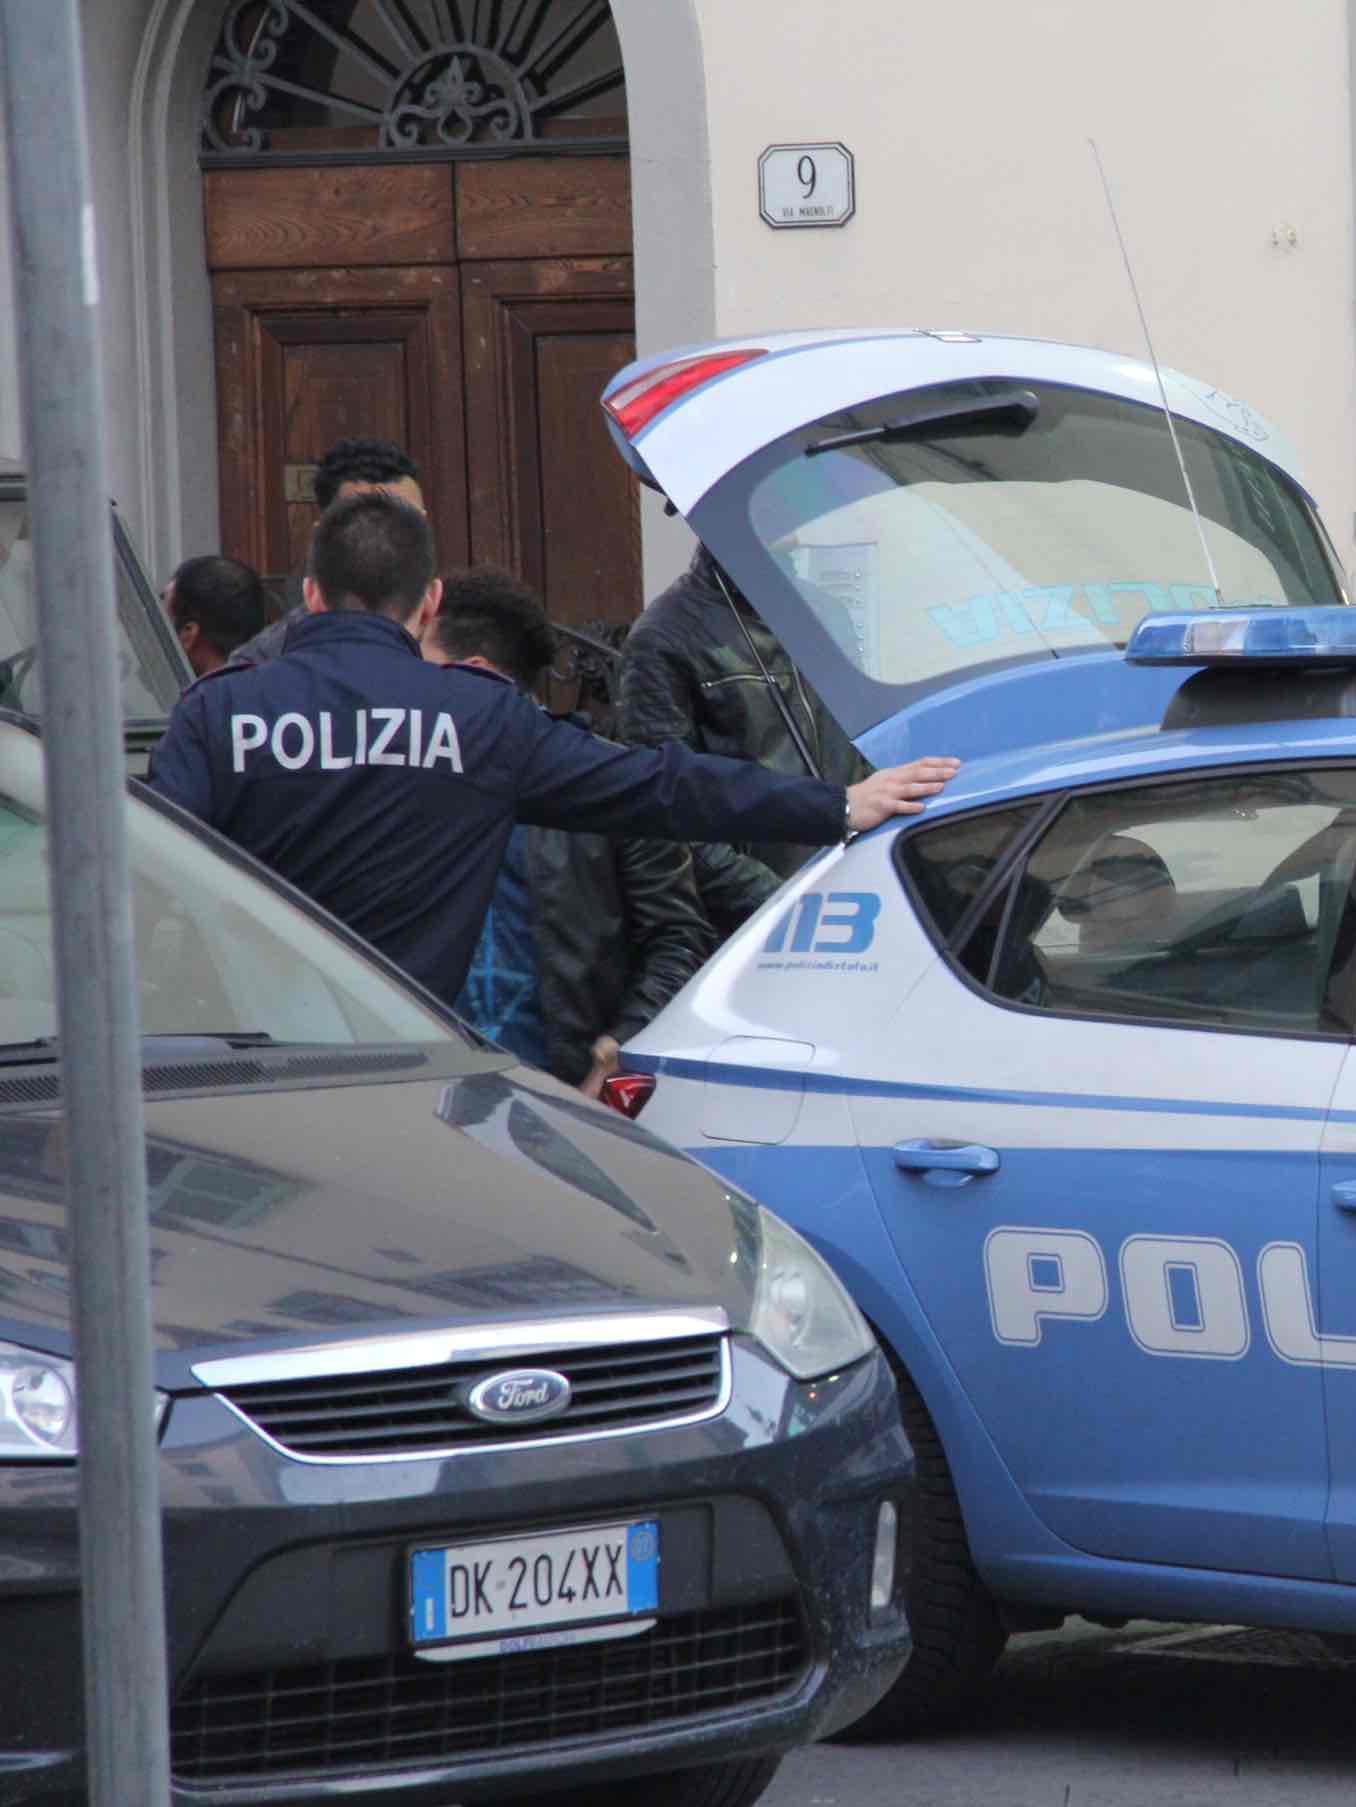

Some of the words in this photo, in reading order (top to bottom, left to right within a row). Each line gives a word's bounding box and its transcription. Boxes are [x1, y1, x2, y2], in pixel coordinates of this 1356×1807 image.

[797, 155, 817, 200] 9
[230, 707, 465, 775] POLIZIA
[496, 1377, 550, 1411] Ford
[449, 1560, 494, 1619] DK
[507, 1543, 624, 1612] 204XX
